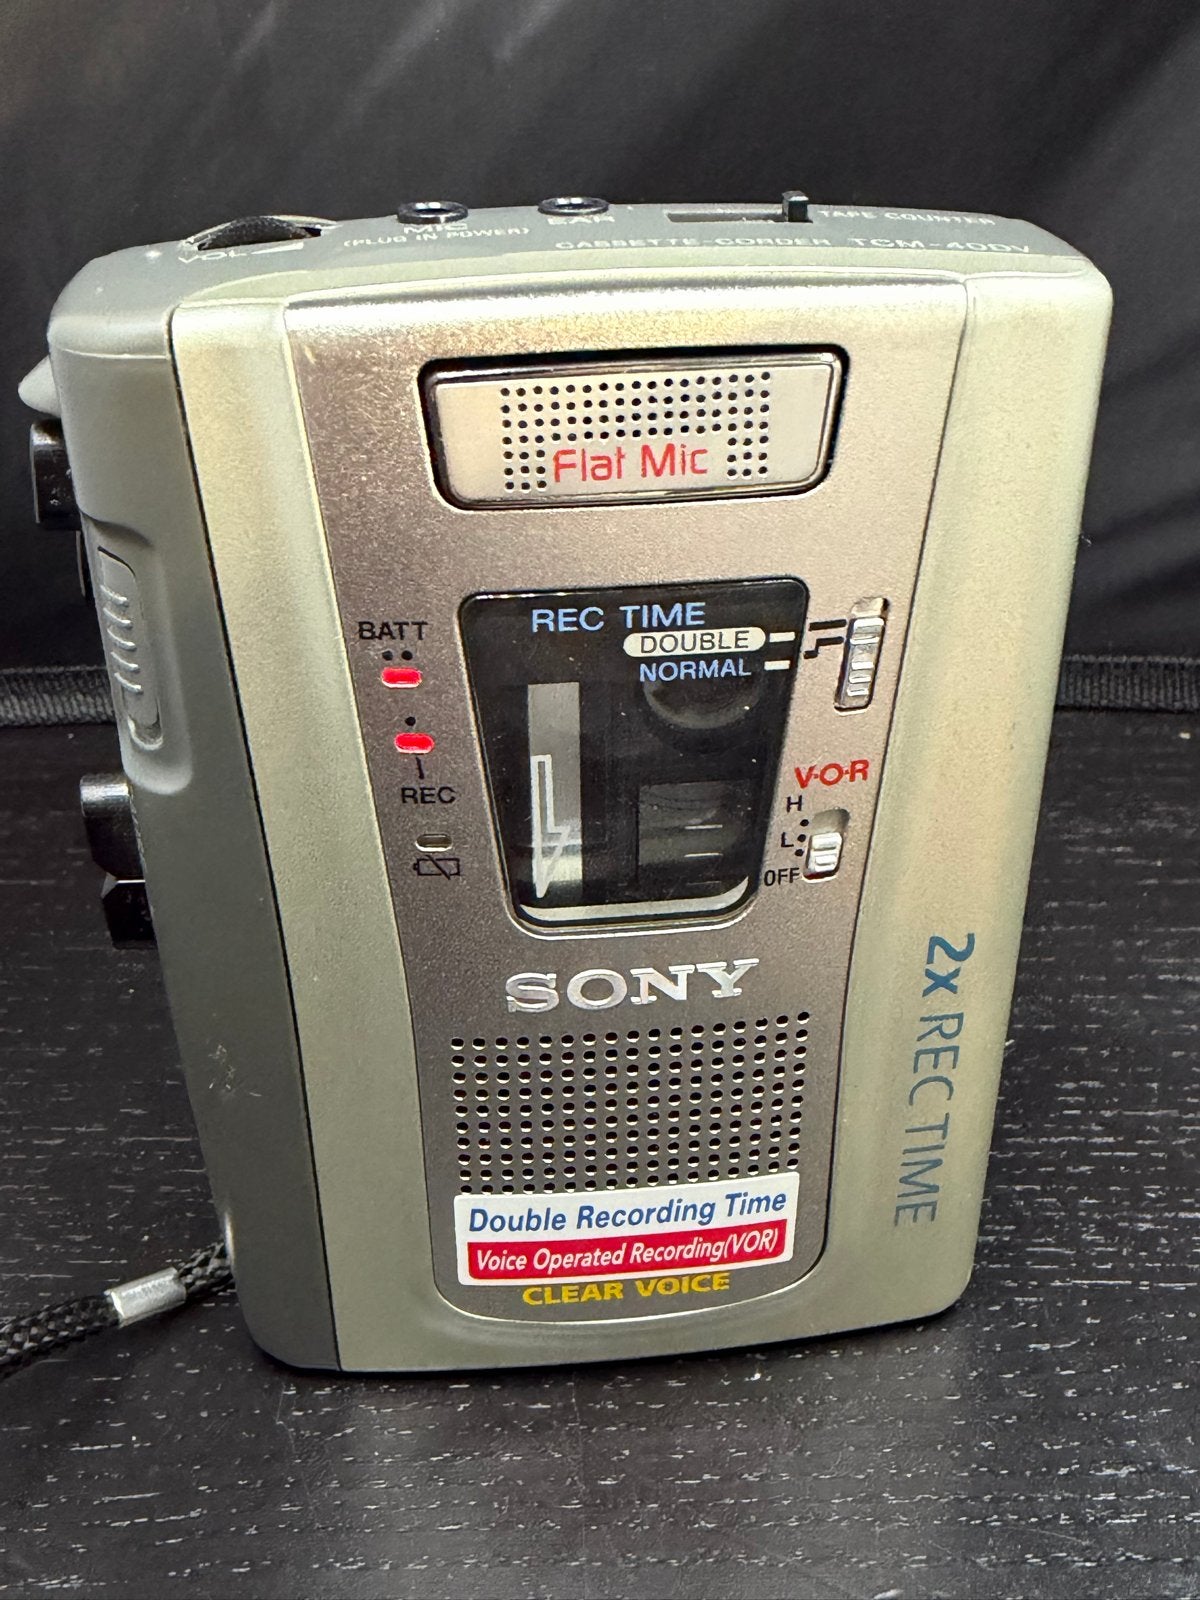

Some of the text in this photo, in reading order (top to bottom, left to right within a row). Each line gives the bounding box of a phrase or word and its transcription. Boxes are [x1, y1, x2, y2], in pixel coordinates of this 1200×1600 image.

[817, 210, 996, 226] TAPE COUNTER
[343, 227, 531, 247] (PLUG IN POWER)
[553, 443, 709, 483] Flat Mic
[531, 602, 707, 633] REC TIME
[358, 621, 429, 641] BATT
[639, 630, 750, 655] DOUBLE
[639, 658, 753, 683] NORMAL
[400, 786, 457, 805] REC
[786, 795, 803, 813] H
[781, 832, 795, 848] L
[764, 867, 800, 887] OFF
[505, 958, 760, 1013] SONY
[908, 1011, 965, 1106] REC
[894, 1112, 950, 1227] TIME
[469, 1192, 787, 1233] Double Recording Time
[476, 1250, 527, 1272] Voice
[532, 1243, 623, 1275] Operated
[522, 1272, 731, 1306] CLEAR VOICE
